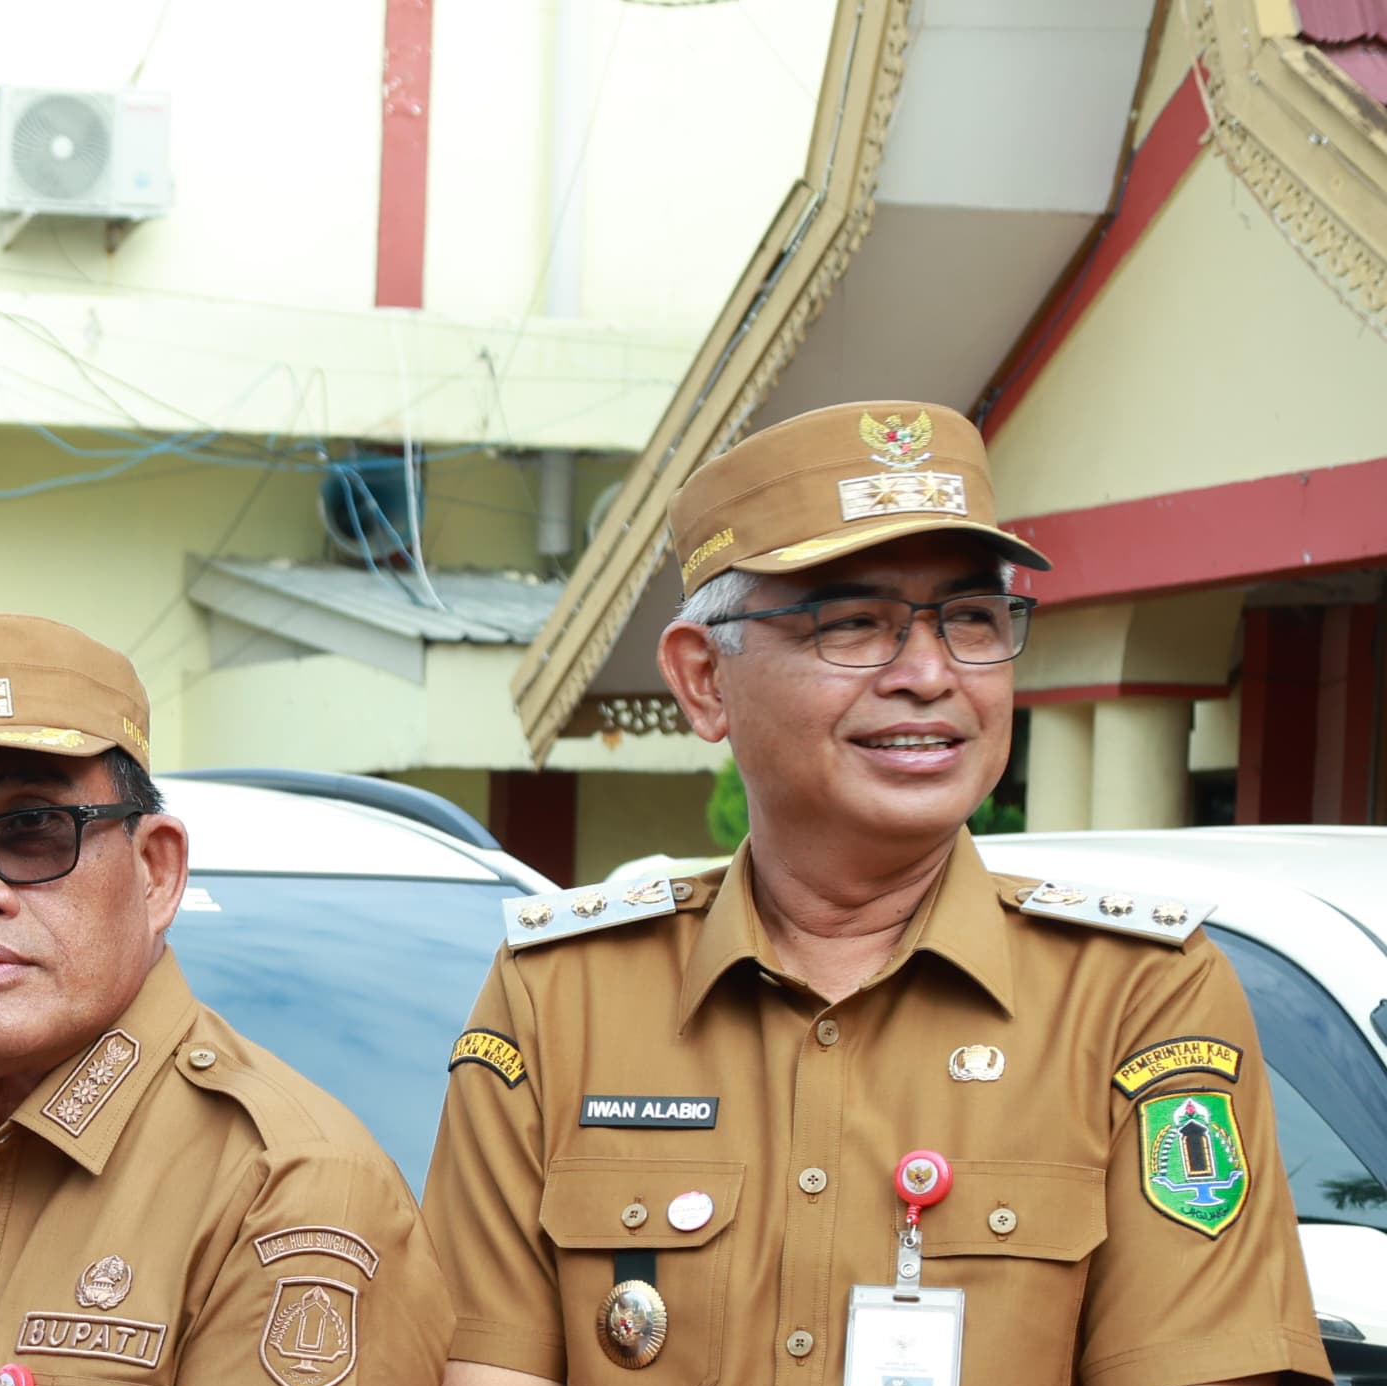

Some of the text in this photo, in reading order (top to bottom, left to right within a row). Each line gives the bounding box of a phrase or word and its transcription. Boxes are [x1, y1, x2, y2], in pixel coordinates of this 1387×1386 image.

[482, 1048, 516, 1077] NEGERI
[1120, 1042, 1201, 1081] PEMERINTAH
[1172, 1055, 1214, 1067] UTARA
[587, 1101, 711, 1119] IWAN ALABIO
[289, 1231, 314, 1249] HULU
[316, 1232, 349, 1254] SUNGAI
[26, 1319, 150, 1358] BUPATI
